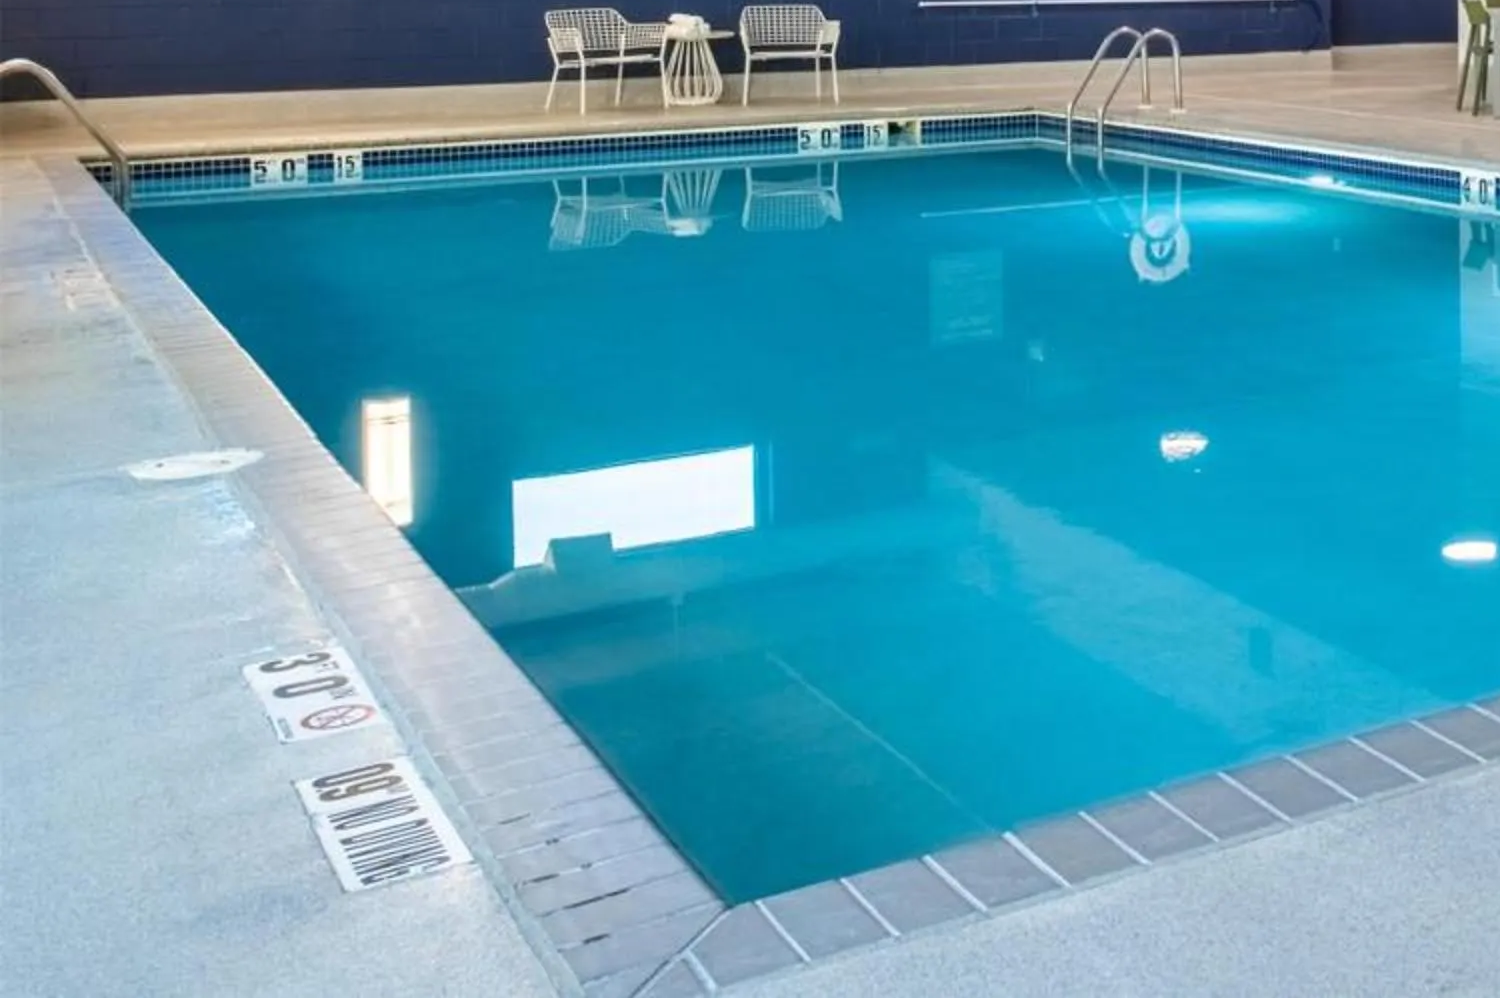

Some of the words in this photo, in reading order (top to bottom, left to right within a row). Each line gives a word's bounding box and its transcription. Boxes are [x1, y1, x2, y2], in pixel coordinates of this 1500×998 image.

[259, 652, 331, 673] 3
[273, 676, 349, 699] 0
[327, 794, 420, 831] NO
[339, 818, 452, 886] DIVING
